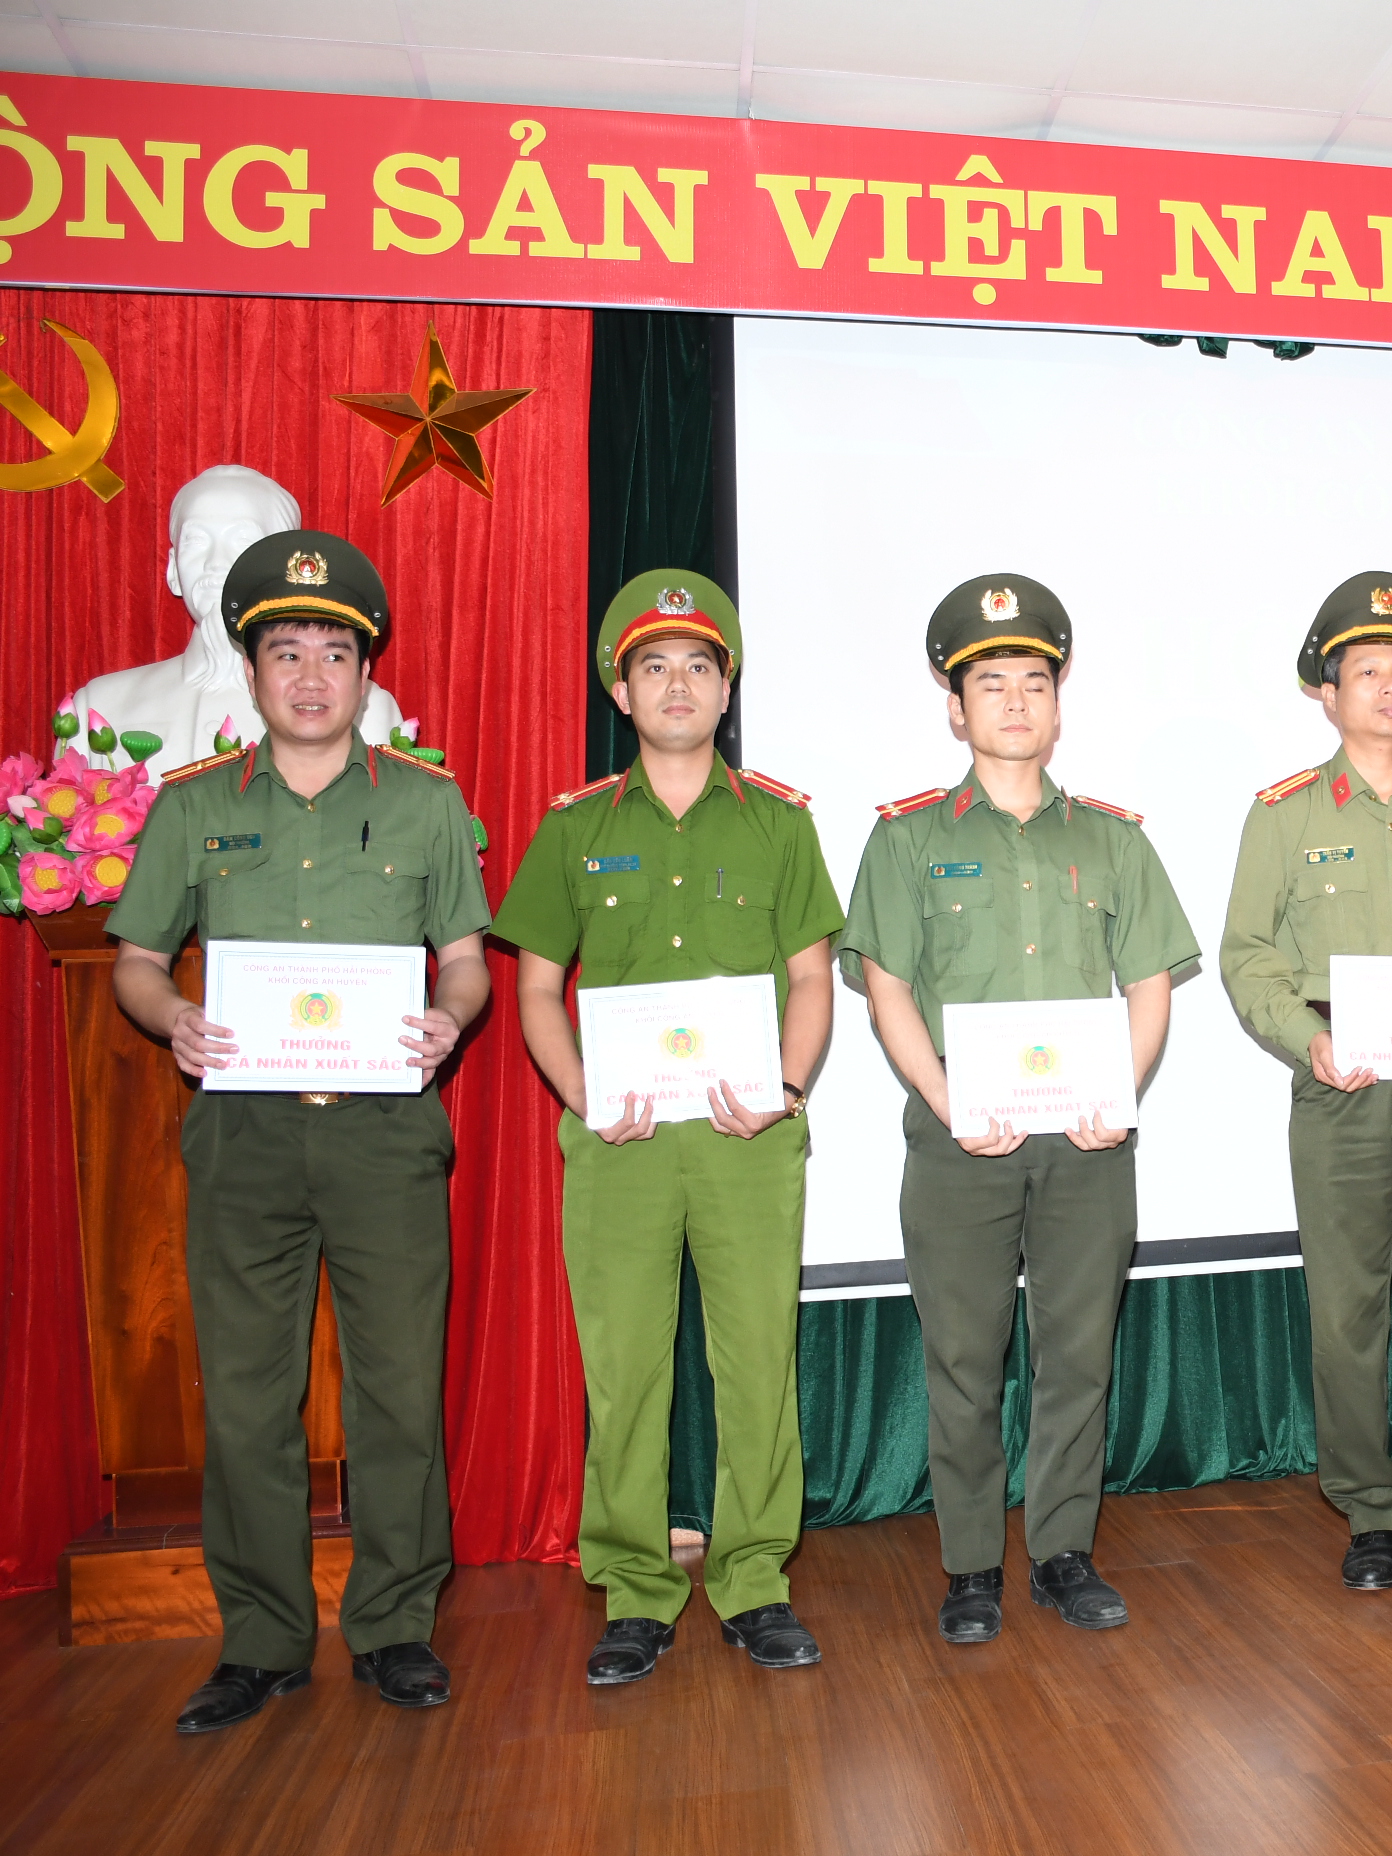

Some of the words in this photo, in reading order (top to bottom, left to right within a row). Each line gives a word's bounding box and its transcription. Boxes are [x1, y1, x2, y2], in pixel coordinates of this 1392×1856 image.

[373, 119, 709, 263] SẢN
[756, 154, 1118, 305] VIỆT
[243, 964, 270, 972] CÔNG
[292, 976, 319, 985] CÔNG
[280, 1035, 352, 1051] THƯỞNG
[227, 1056, 250, 1069] CÁ
[257, 1056, 308, 1070] NHÂN
[315, 1055, 360, 1070] XUẤT
[366, 1056, 402, 1071] SẮC
